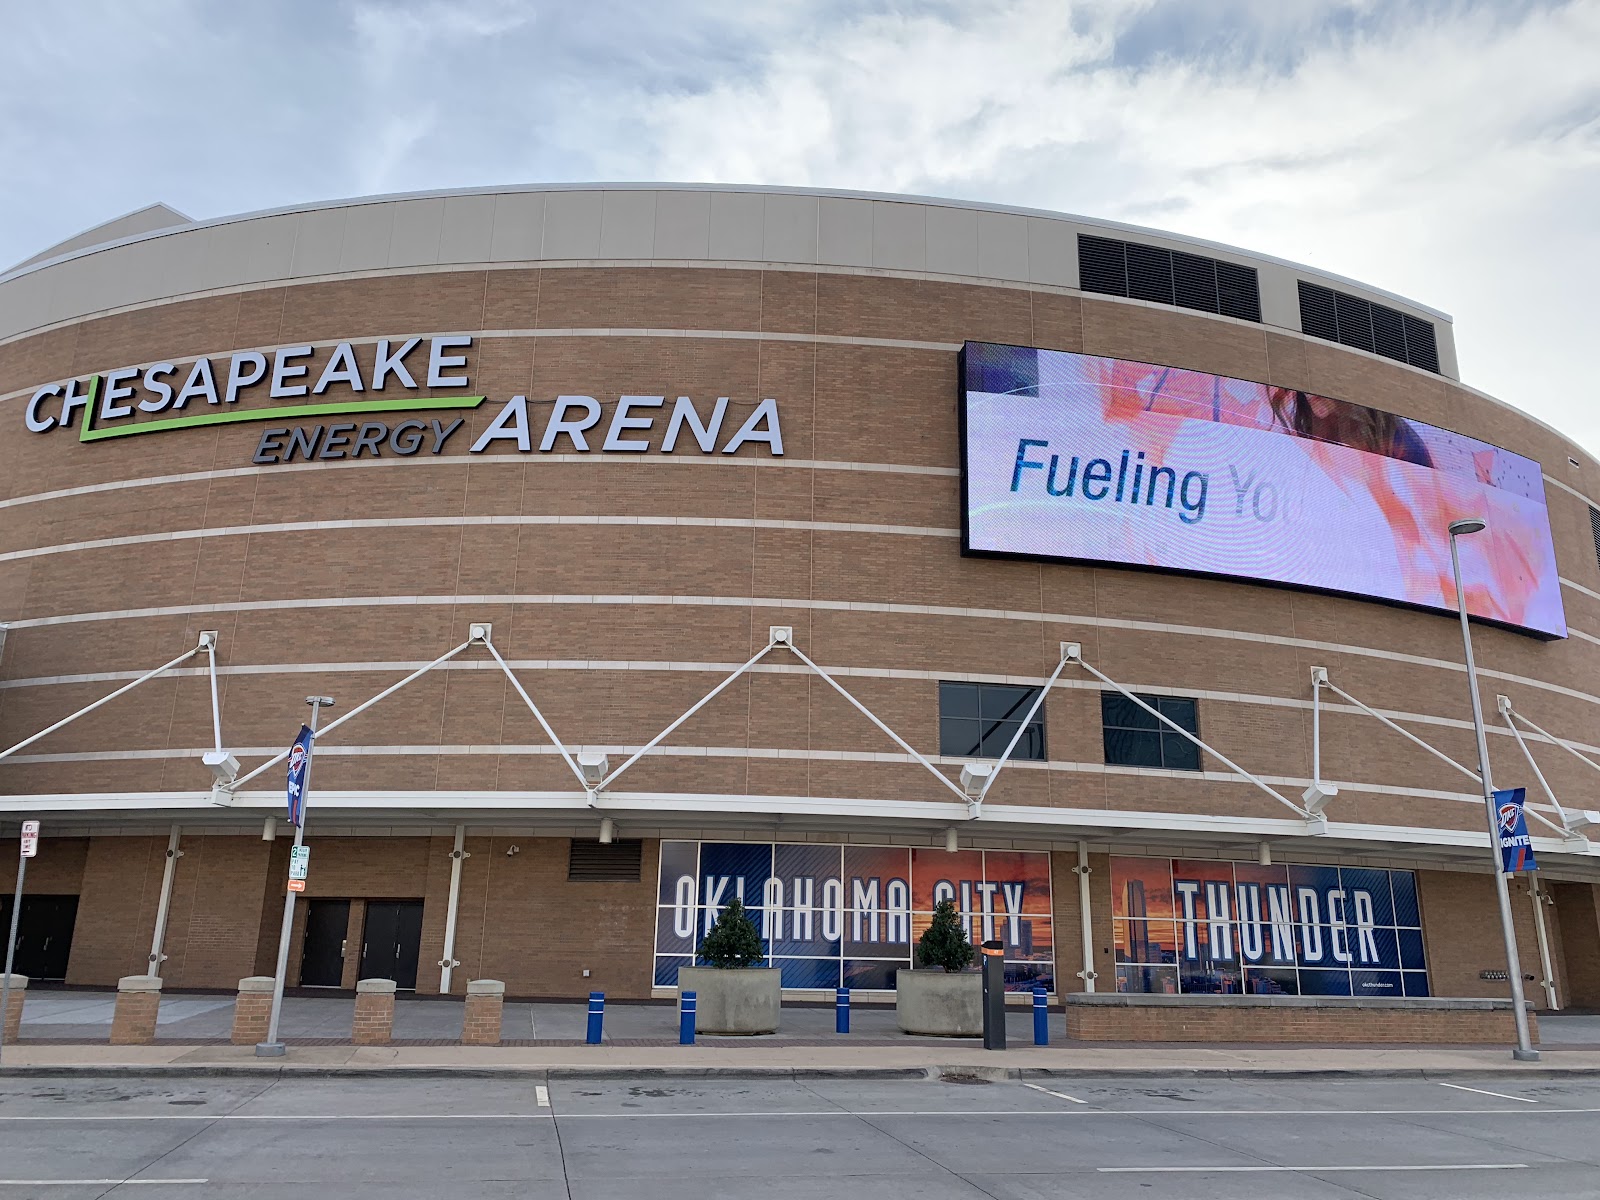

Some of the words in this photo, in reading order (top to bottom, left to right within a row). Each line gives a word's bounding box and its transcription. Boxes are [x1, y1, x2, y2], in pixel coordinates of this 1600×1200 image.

[25, 335, 473, 441] CHESAPEAKE
[252, 418, 465, 463] ENERGY
[469, 395, 784, 455] ARENA
[1010, 438, 1209, 524] Fueling
[1500, 808, 1515, 828] OKC
[1500, 834, 1530, 848] IGNITE
[1177, 882, 1380, 963] THUNDER
